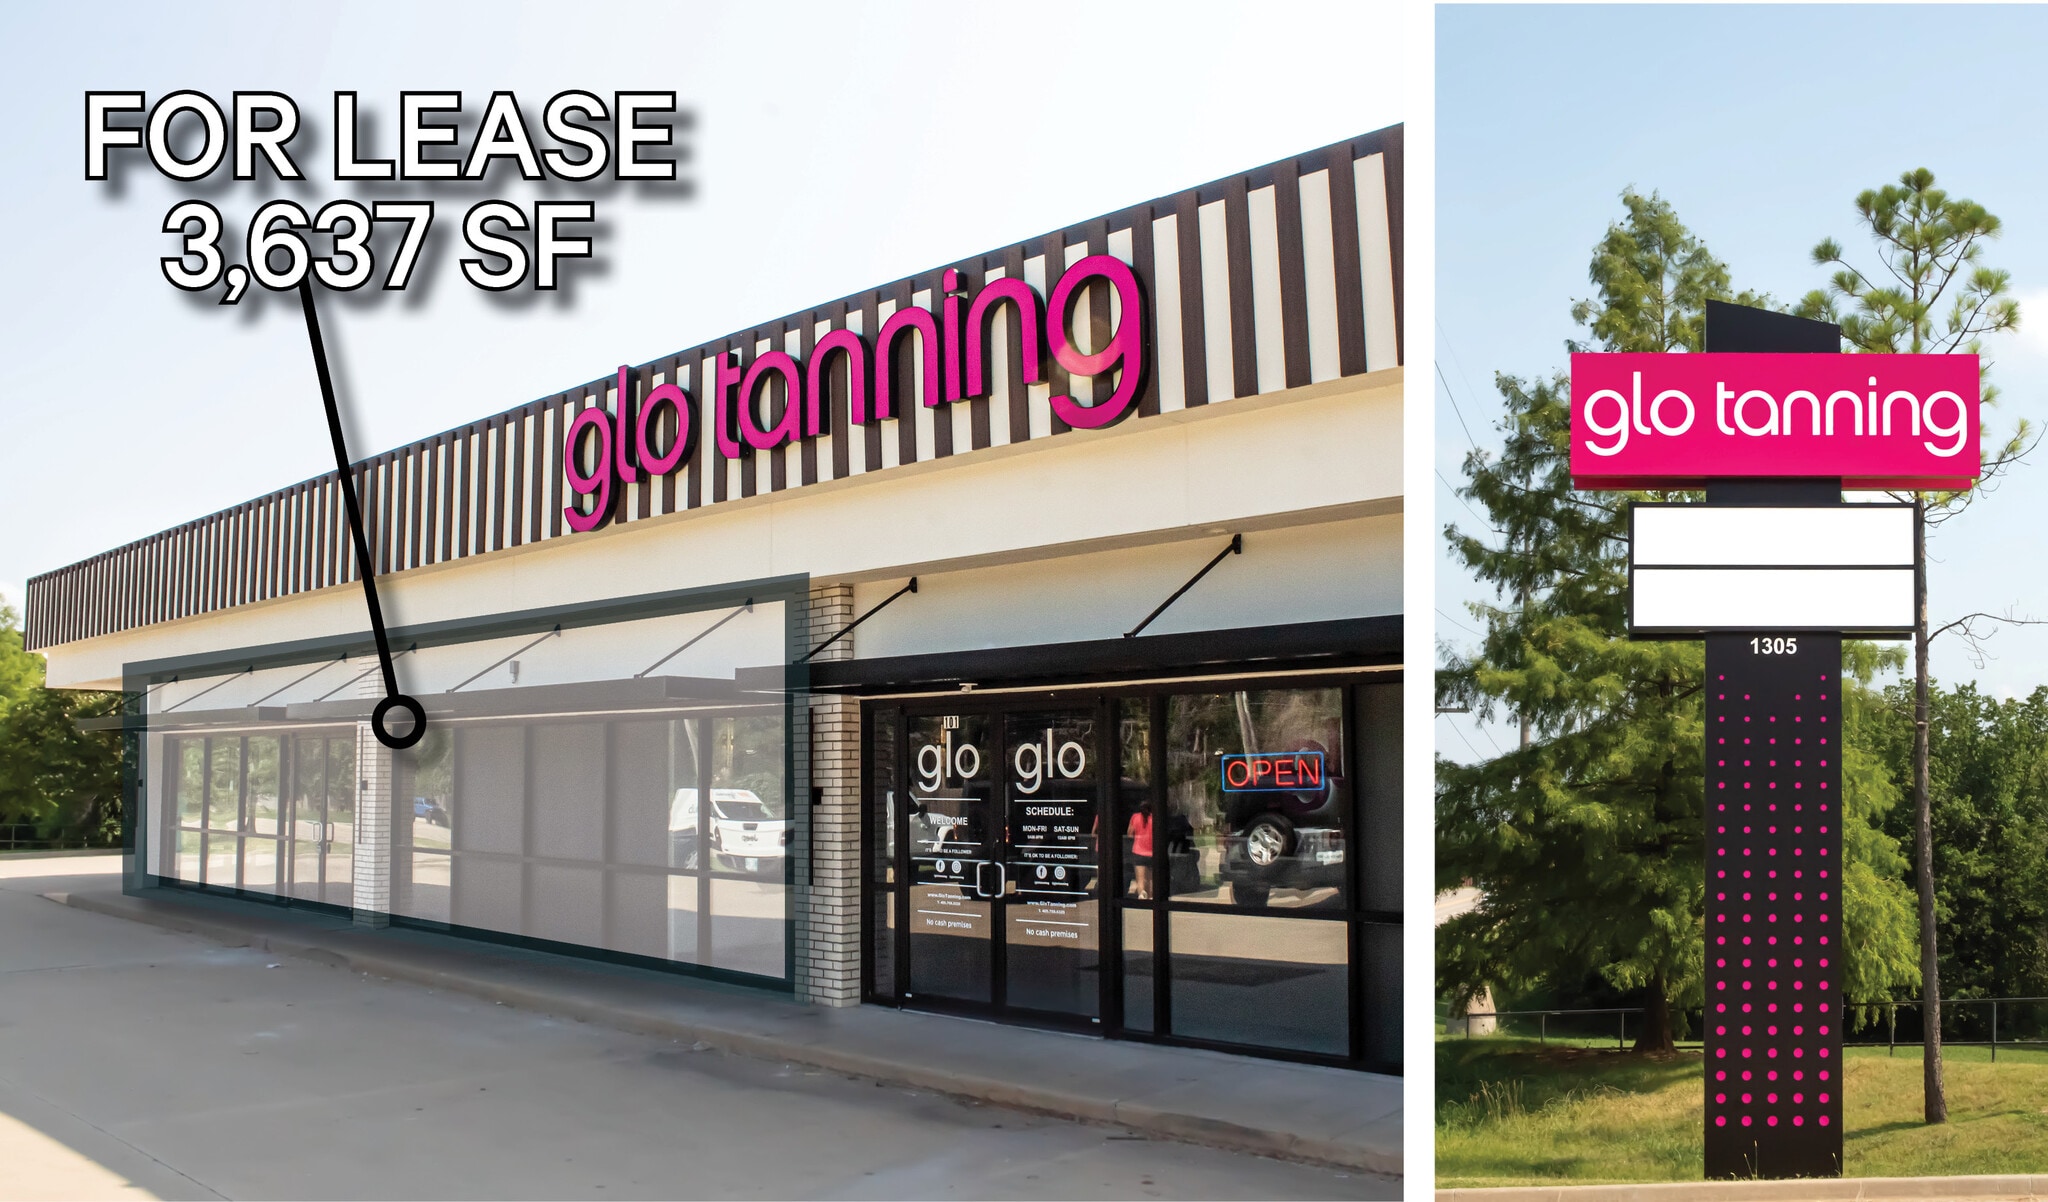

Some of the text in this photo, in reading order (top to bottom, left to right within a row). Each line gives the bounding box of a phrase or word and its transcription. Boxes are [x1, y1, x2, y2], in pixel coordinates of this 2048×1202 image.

[564, 255, 1149, 532] glo tanning
[1583, 371, 1968, 458] glo tanning
[1750, 637, 1797, 655] 1305
[944, 716, 959, 728] 101
[918, 731, 980, 792] glo
[1015, 728, 1086, 794] glo
[1227, 758, 1320, 787] OPEN
[1025, 806, 1075, 816] SCHEDULE:
[929, 817, 968, 826] WELCOME
[1053, 825, 1080, 833] SAT-SUN
[947, 920, 972, 929] premises
[1035, 929, 1049, 937] cash
[1050, 930, 1078, 939] premises
